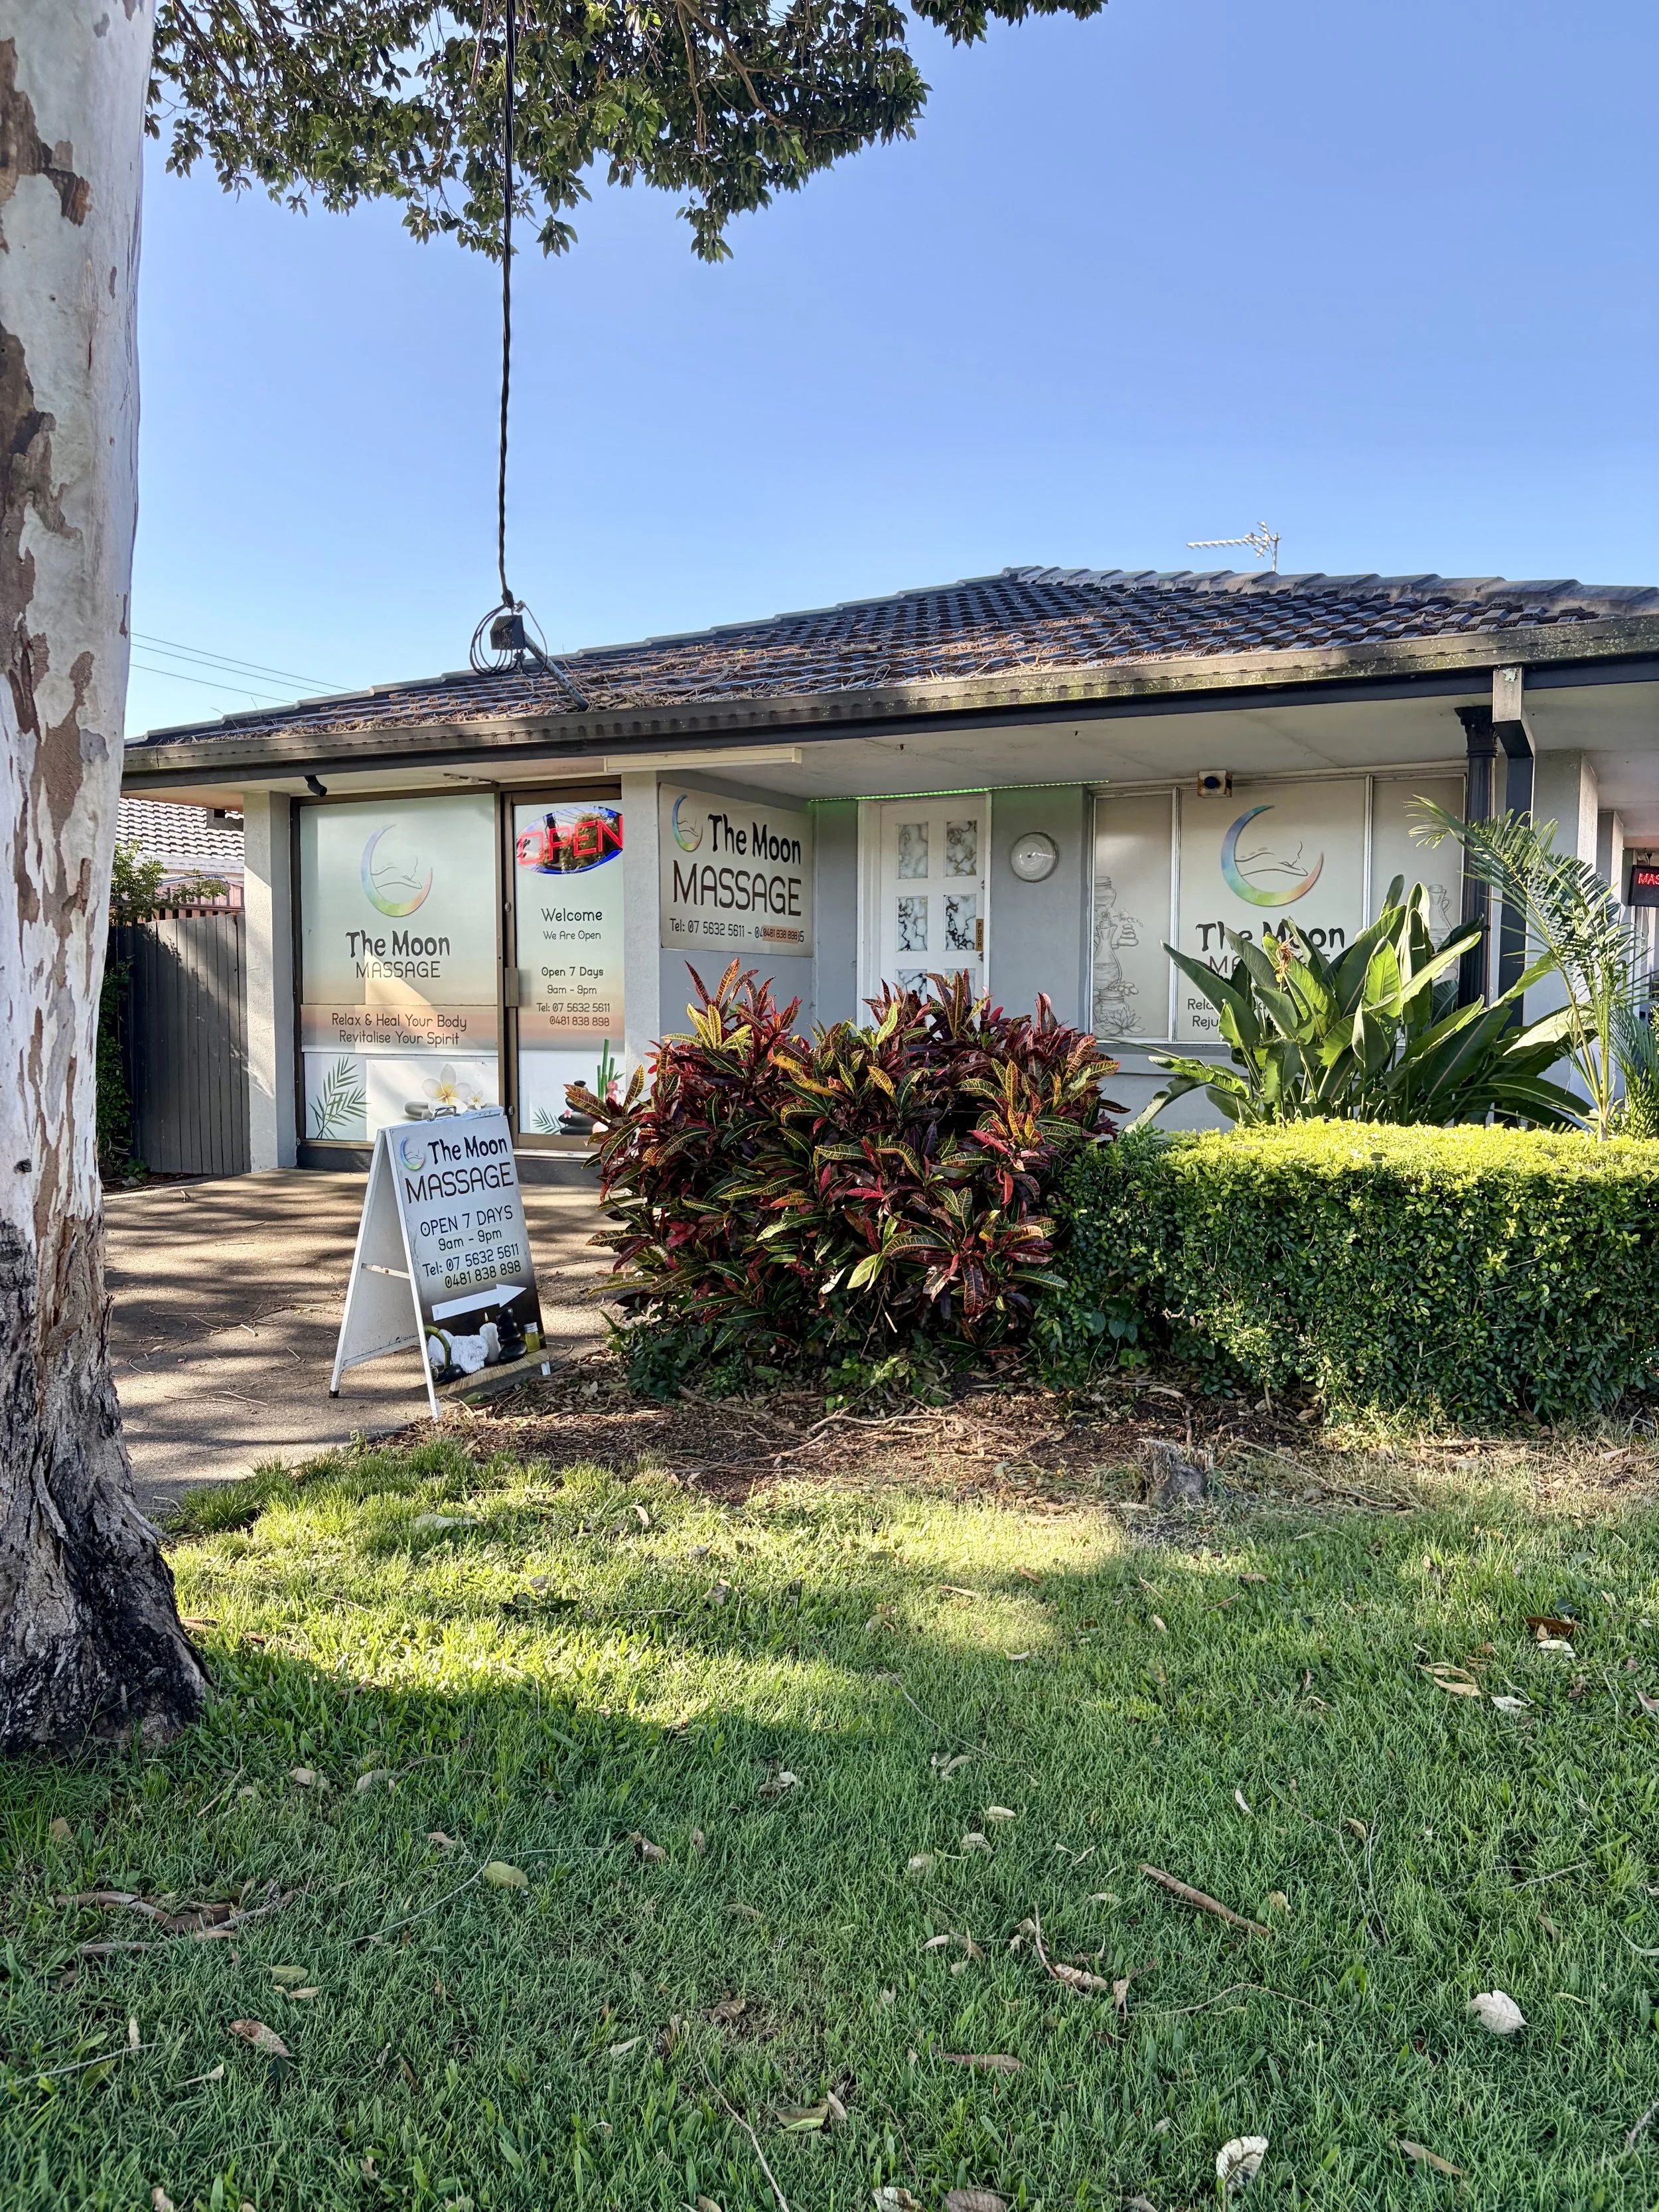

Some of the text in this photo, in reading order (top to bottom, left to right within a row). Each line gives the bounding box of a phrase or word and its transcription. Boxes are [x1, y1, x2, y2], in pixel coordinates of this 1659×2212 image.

[517, 815, 623, 865] OPEN
[707, 813, 801, 865] The Moon
[673, 859, 802, 917] MASSAGE
[541, 908, 603, 922] Welcome
[543, 930, 601, 942] We Are Open
[670, 919, 685, 932] Tel:
[687, 920, 699, 933] 07
[703, 921, 725, 936] 5632
[728, 924, 745, 938] 5611
[763, 928, 775, 938] 0481
[776, 929, 786, 939] 838
[788, 930, 798, 940] 898
[346, 930, 450, 958] The Moon
[356, 961, 441, 978] MASSAGE
[541, 967, 604, 978] Open 7 Days
[547, 984, 567, 994] 9am
[577, 985, 597, 996] 9pm
[536, 1003, 610, 1013] Tel: 07 5632 5611
[332, 1013, 467, 1031] Relax & Heal Your Body
[549, 1016, 610, 1027] 0481 838 898
[340, 1030, 459, 1048] Revitalise Your Spirit
[427, 1136, 508, 1165] The Moon
[405, 1161, 514, 1204] MASSAGE
[420, 1205, 513, 1236] OPEN 7 DAYS
[438, 1238, 464, 1251] 9am
[478, 1230, 502, 1244] 9pm
[422, 1243, 519, 1277] Tel: 07 5632 5611
[445, 1260, 521, 1288] 0481 838 898
